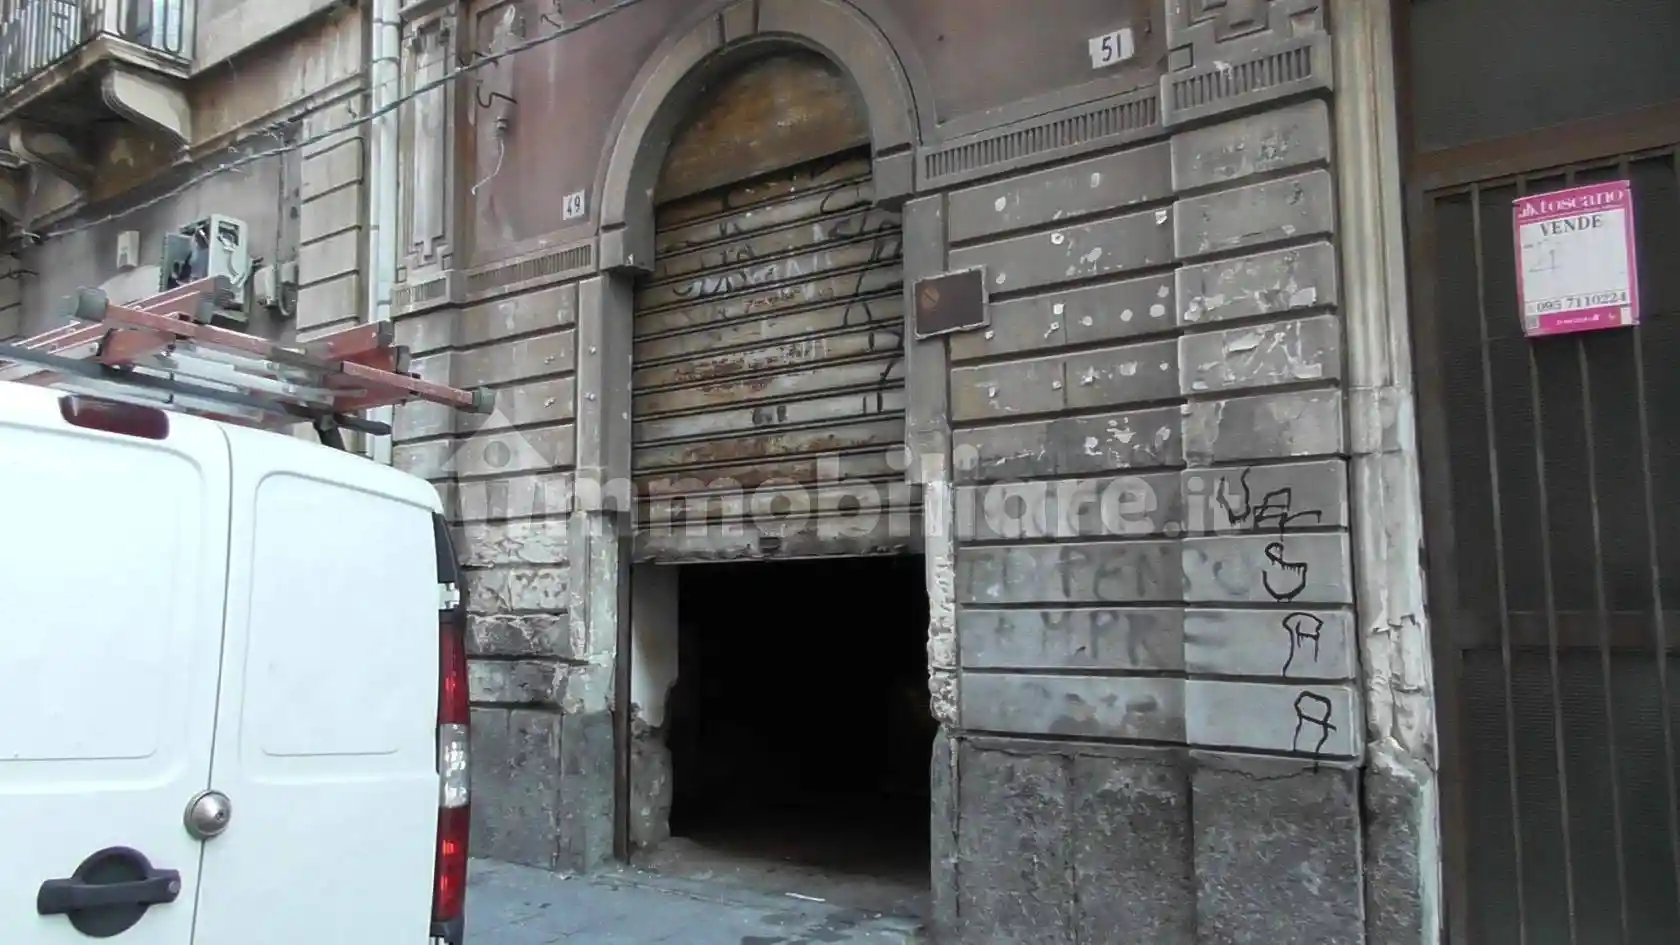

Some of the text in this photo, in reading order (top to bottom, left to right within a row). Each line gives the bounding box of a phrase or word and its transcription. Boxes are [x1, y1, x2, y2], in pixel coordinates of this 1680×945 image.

[1101, 33, 1122, 62] 51
[566, 194, 581, 217] 49
[1540, 189, 1624, 214] toscano
[1540, 214, 1604, 237] VENDE
